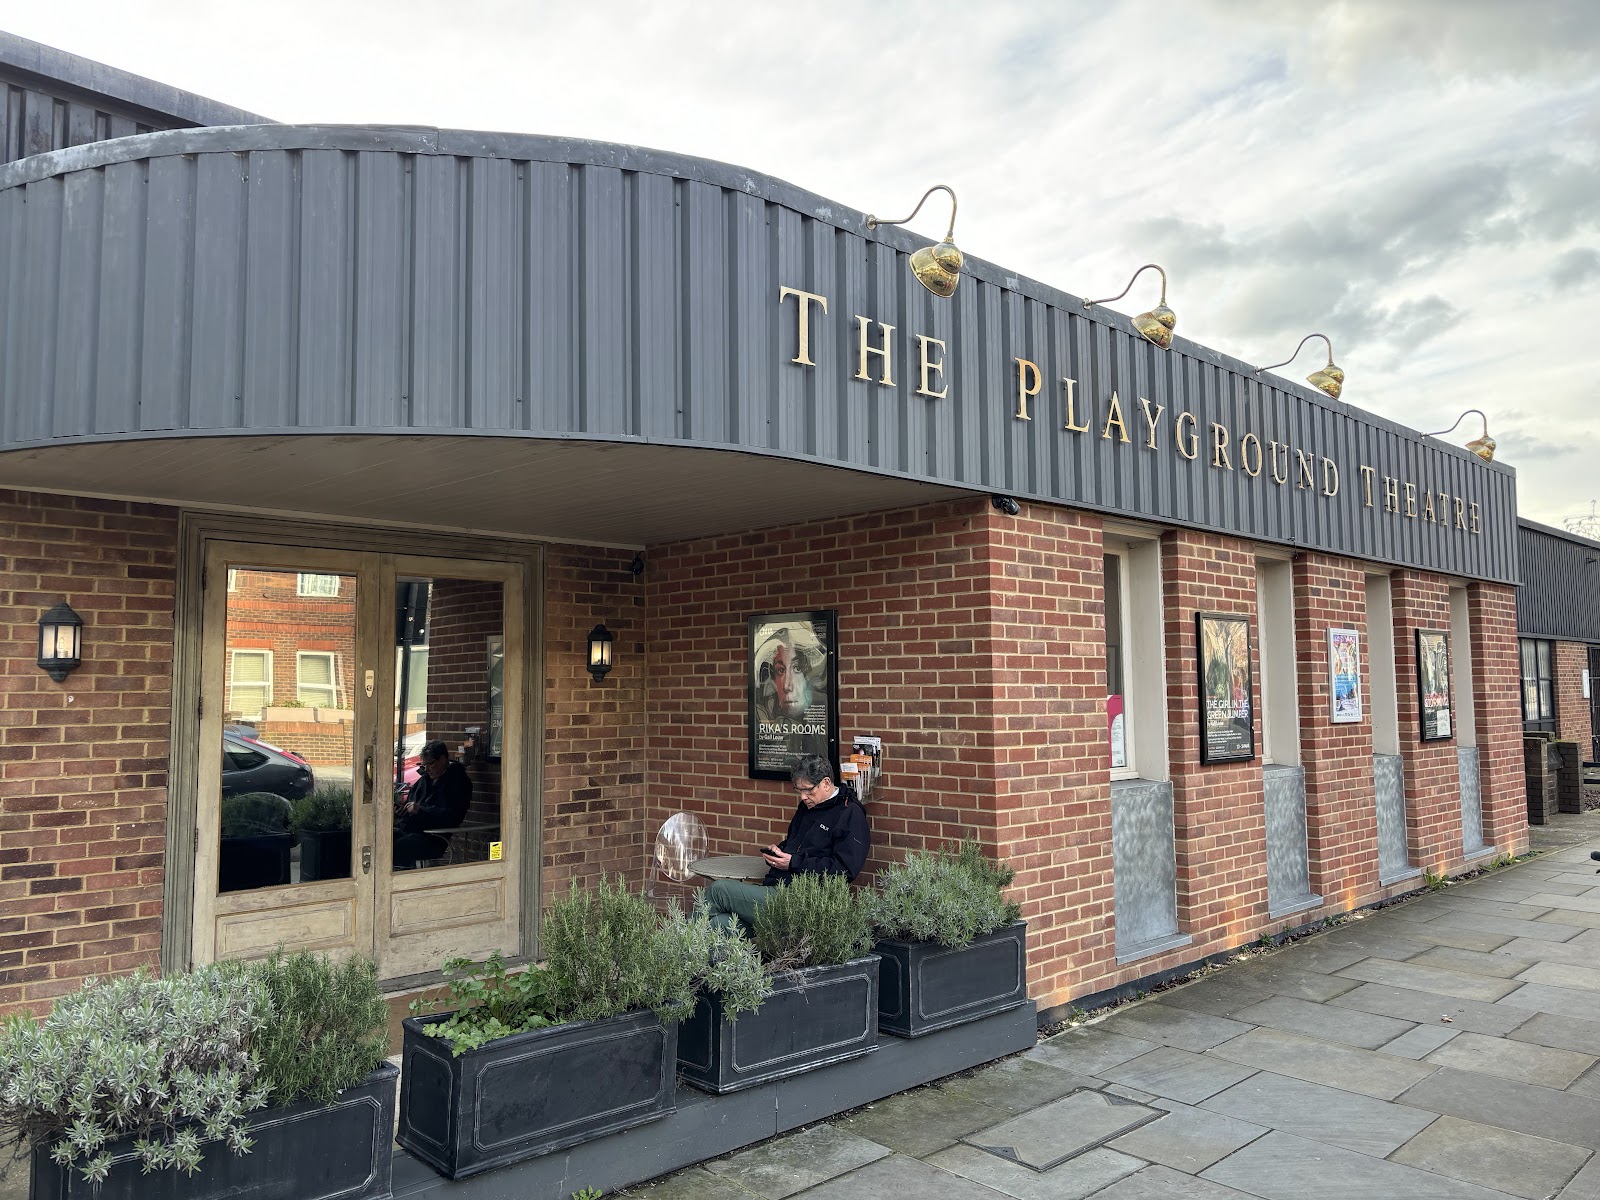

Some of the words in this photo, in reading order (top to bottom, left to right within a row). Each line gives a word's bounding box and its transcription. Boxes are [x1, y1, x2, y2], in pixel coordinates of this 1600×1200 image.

[779, 285, 948, 399] THE
[1014, 357, 1339, 496] PLAYGROUND
[1360, 464, 1480, 534] THEATRE
[759, 723, 789, 734] RIKA'S
[791, 724, 826, 735] ROOMS
